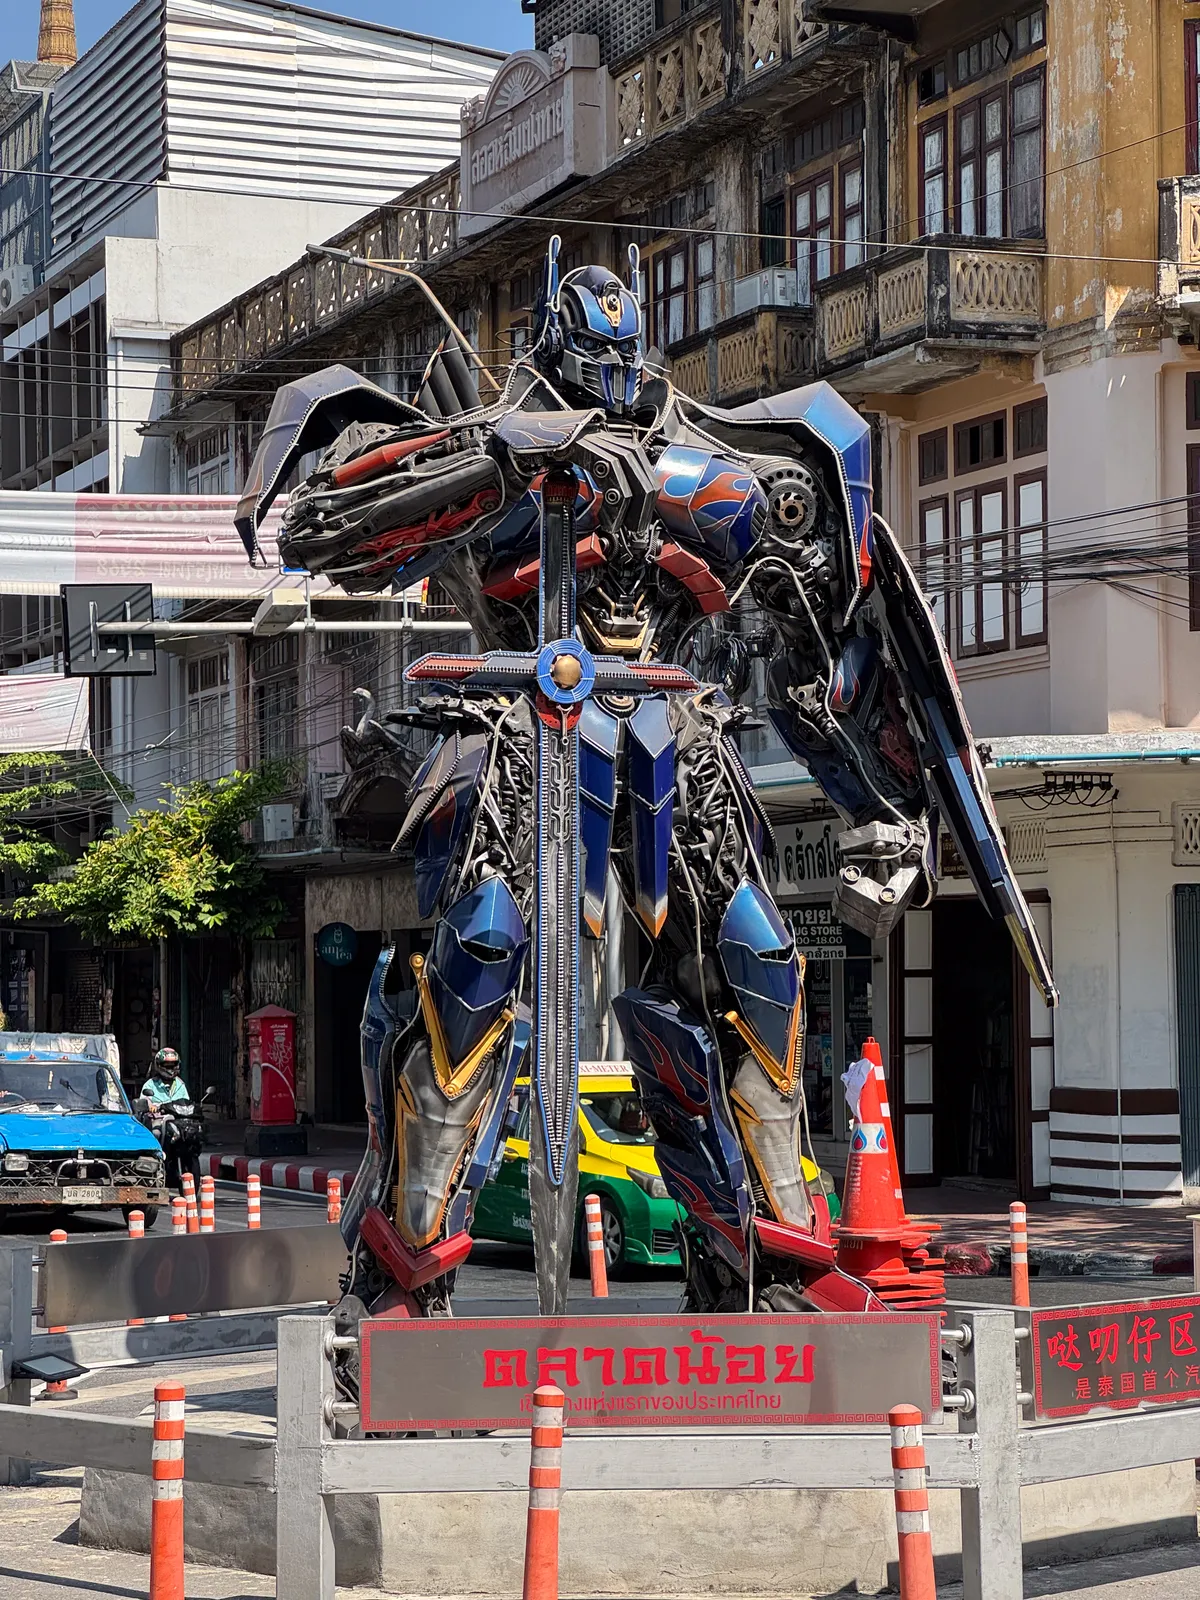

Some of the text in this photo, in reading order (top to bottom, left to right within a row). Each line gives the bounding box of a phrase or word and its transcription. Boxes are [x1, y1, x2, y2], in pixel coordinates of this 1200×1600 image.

[810, 926, 842, 936] STORE
[483, 1329, 816, 1388] ตลาดน้อย
[1047, 1312, 1197, 1372] 哒叨仔区
